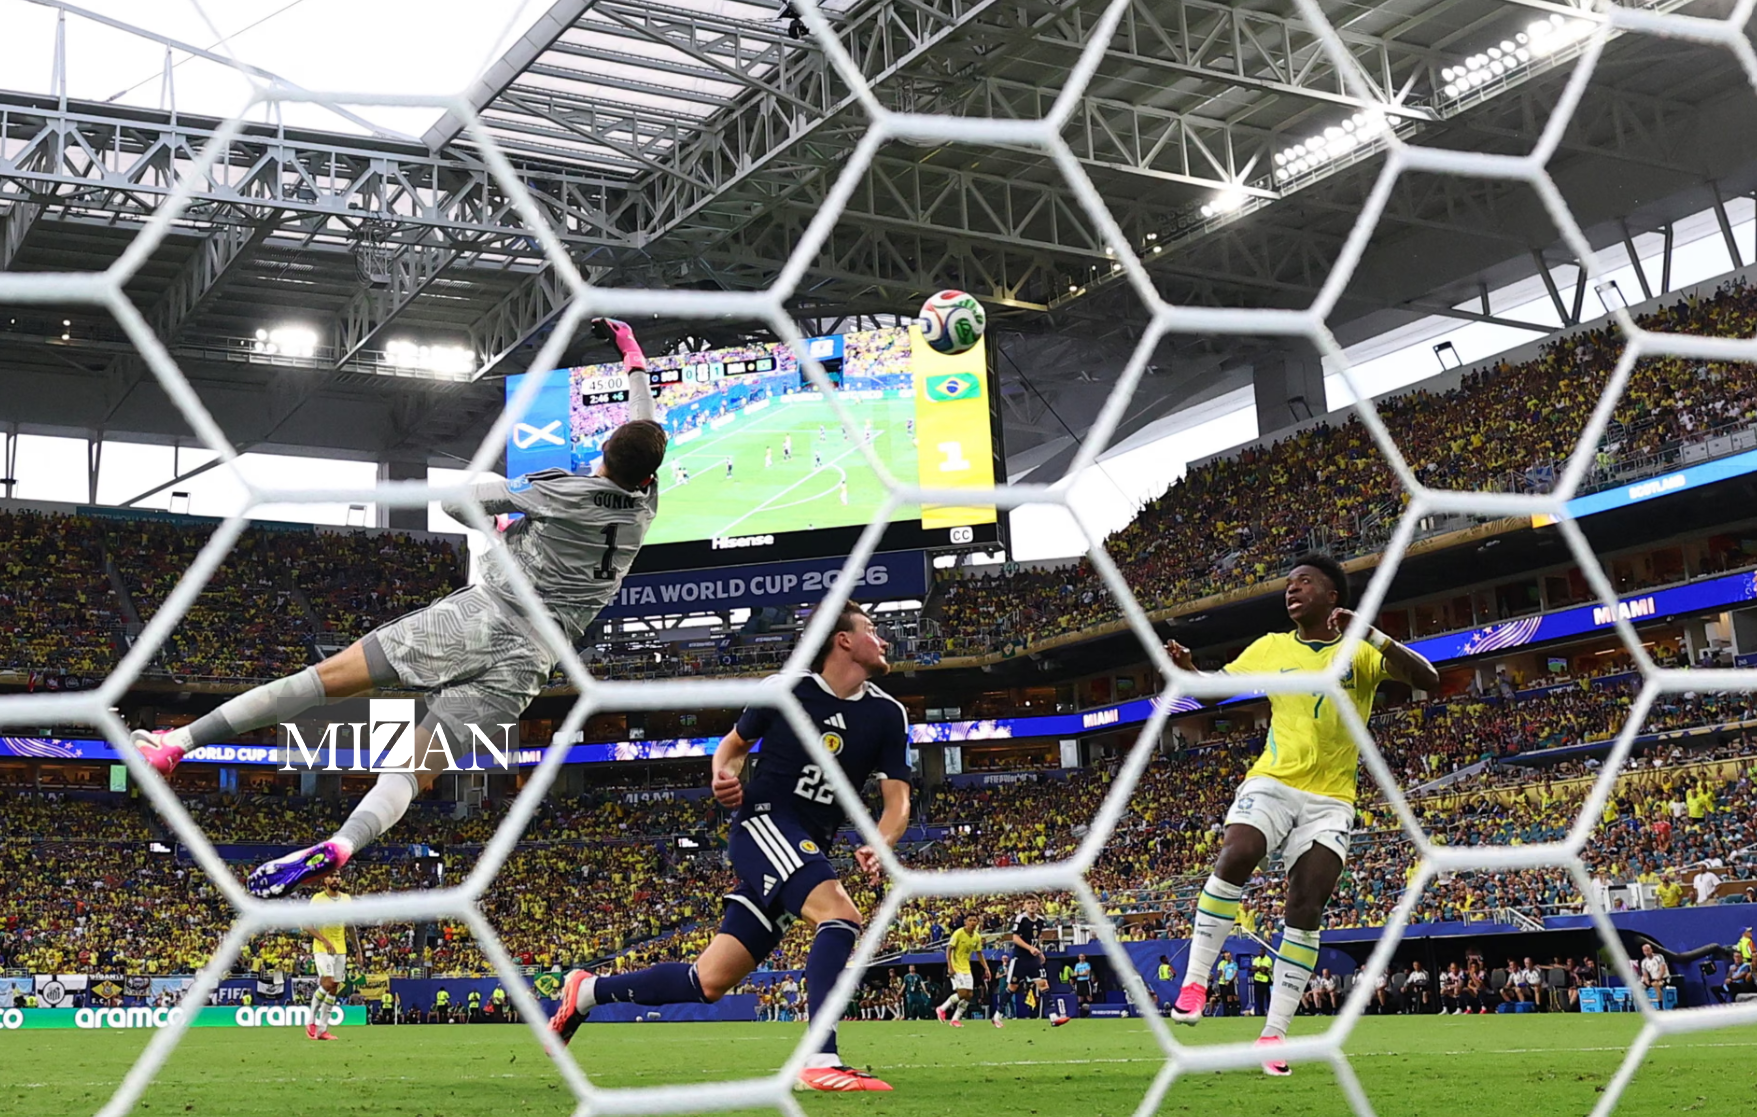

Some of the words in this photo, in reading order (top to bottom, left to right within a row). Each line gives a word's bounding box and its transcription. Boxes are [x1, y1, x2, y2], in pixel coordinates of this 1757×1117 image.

[589, 377, 623, 391] 45:00
[589, 394, 609, 404] 2:46
[937, 441, 971, 472] 1
[1629, 475, 1685, 499] SCOTLAND
[594, 491, 635, 509] GUNN
[712, 535, 774, 550] Hisense
[952, 530, 970, 542] CC
[593, 523, 618, 580] 1
[660, 578, 746, 603] WORLD
[750, 574, 798, 596] CUP
[1593, 596, 1656, 626] MIAMI
[1312, 690, 1326, 719] 7
[1083, 708, 1119, 728] MIAMI
[237, 748, 267, 761] CUP
[74, 1007, 186, 1028] aramco
[235, 1006, 345, 1026] aramo
